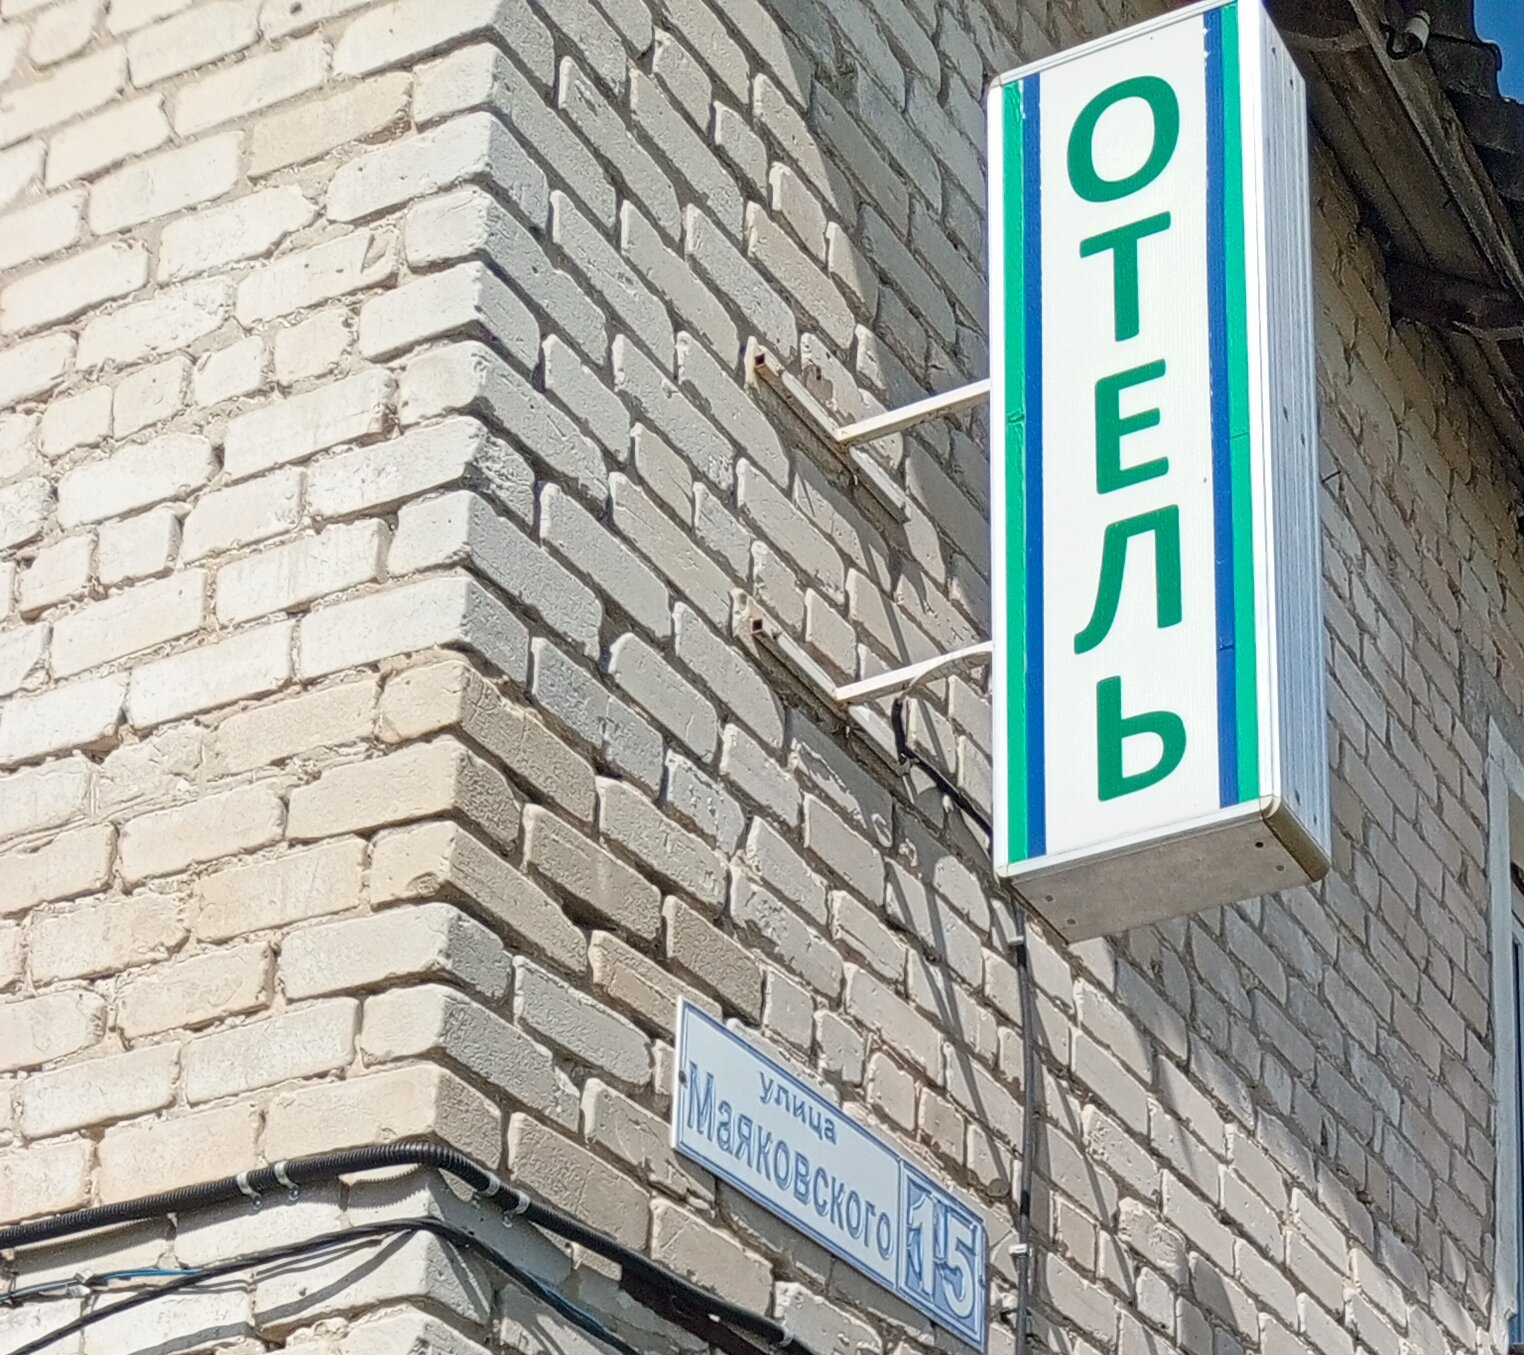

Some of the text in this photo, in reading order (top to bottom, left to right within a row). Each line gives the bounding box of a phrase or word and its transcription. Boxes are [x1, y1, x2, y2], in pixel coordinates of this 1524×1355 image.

[1065, 74, 1188, 803] ОТЕЛЬ
[686, 1059, 894, 1261] Маяковского
[759, 1071, 838, 1145] улица
[908, 1193, 978, 1319] 15
